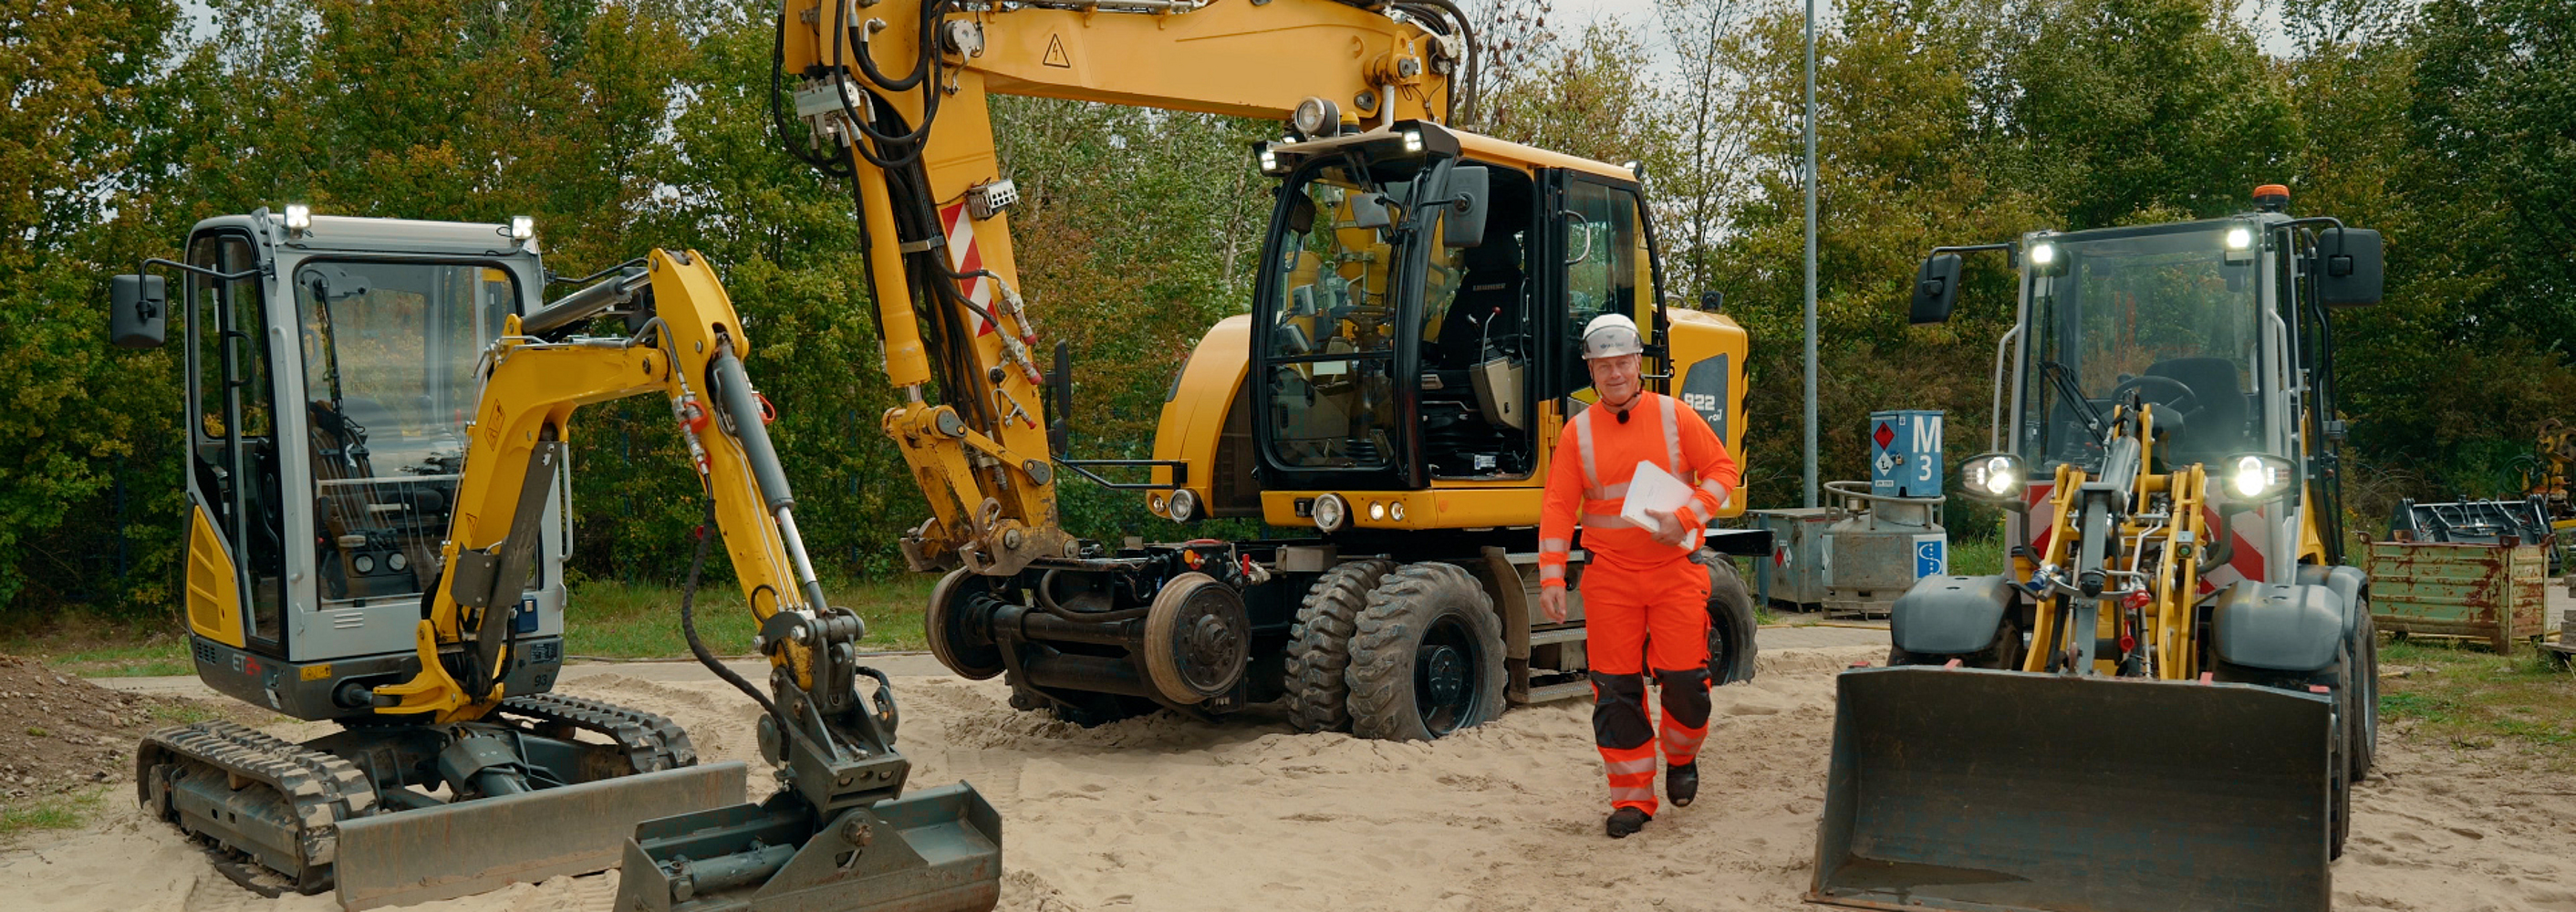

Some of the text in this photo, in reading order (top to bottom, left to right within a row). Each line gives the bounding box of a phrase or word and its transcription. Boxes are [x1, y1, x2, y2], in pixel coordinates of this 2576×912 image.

[1684, 393, 1715, 410] 922
[1913, 416, 1941, 452] M
[1918, 454, 1932, 481] 3
[535, 675, 547, 687] 93
